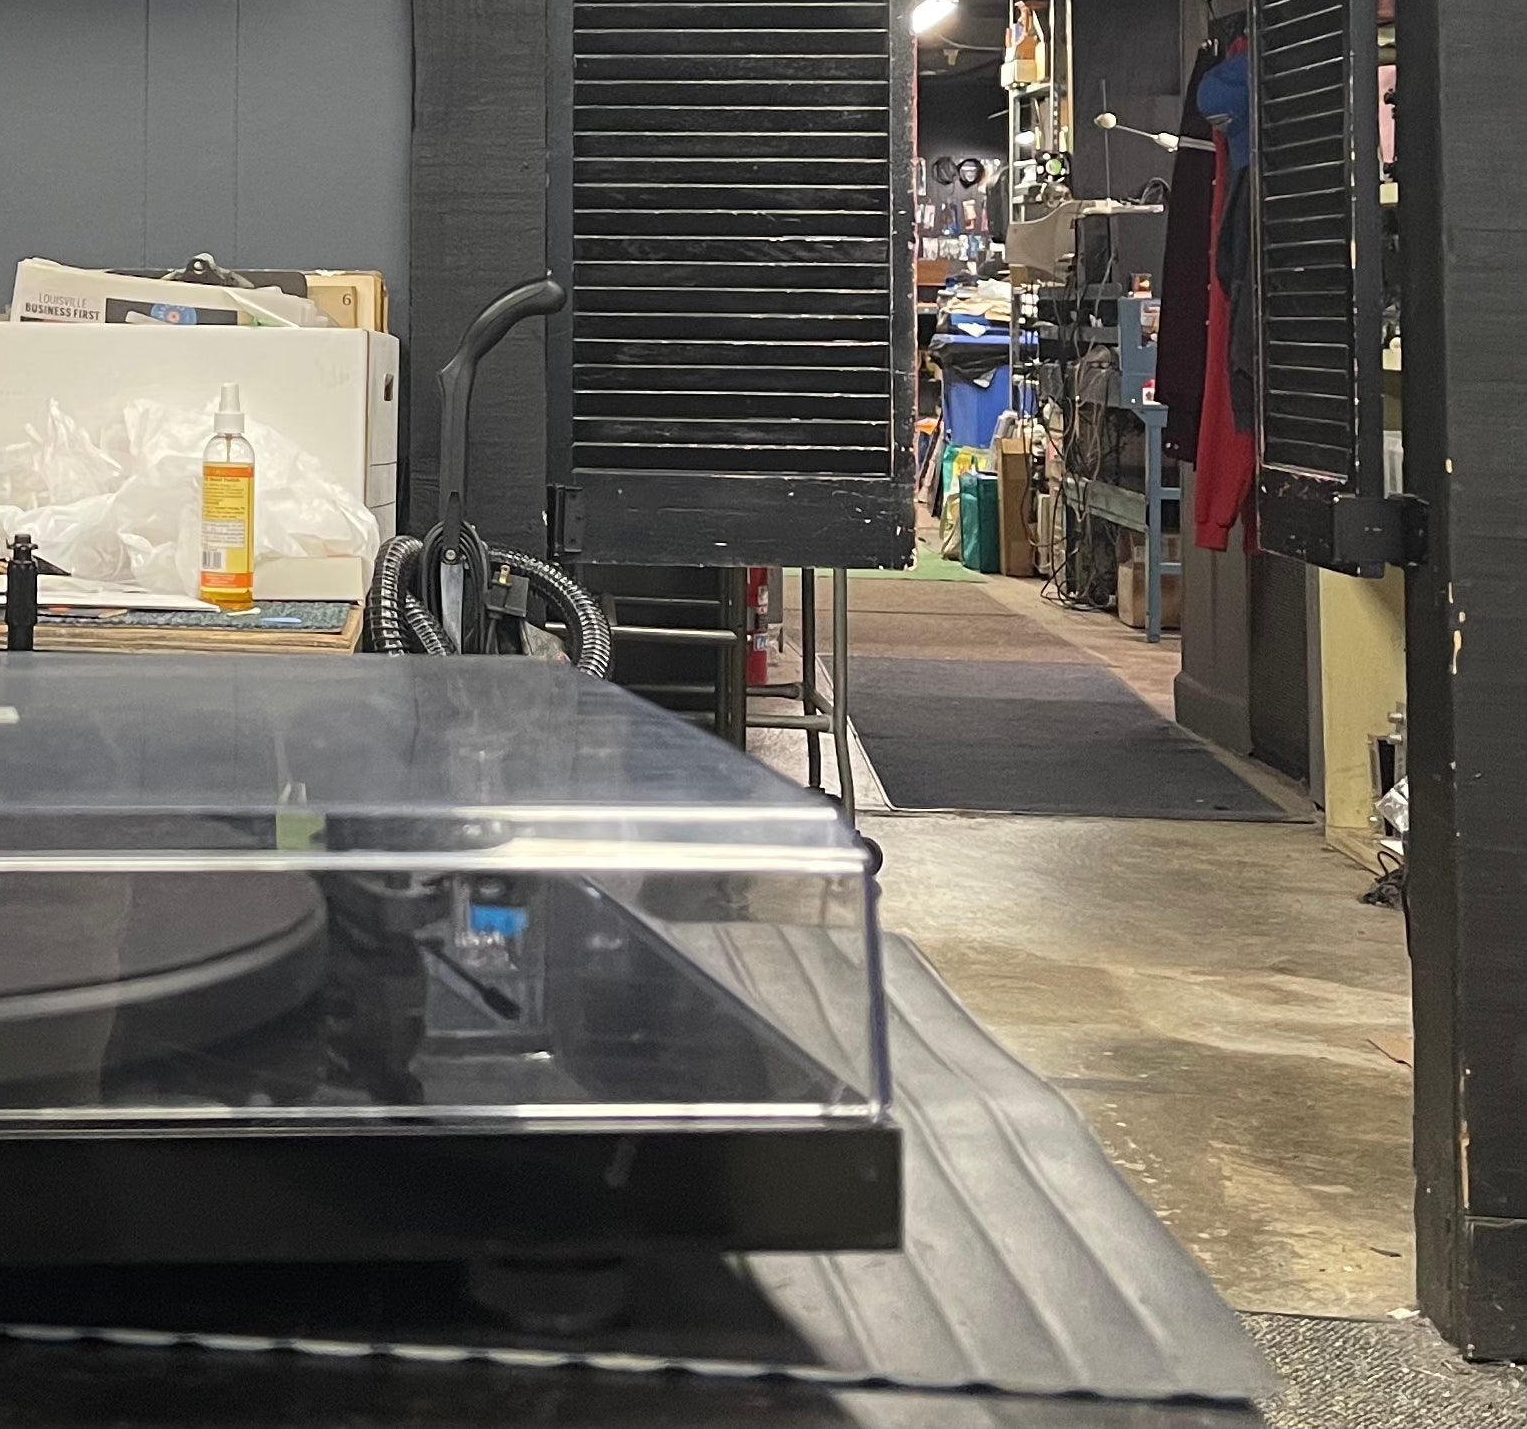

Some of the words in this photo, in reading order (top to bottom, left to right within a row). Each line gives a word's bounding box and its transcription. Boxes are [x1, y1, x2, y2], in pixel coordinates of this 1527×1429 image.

[38, 293, 87, 308] LOUISVILLE
[342, 293, 352, 306] 6
[25, 302, 71, 317] BUSINESS
[73, 308, 100, 320] FIRST
